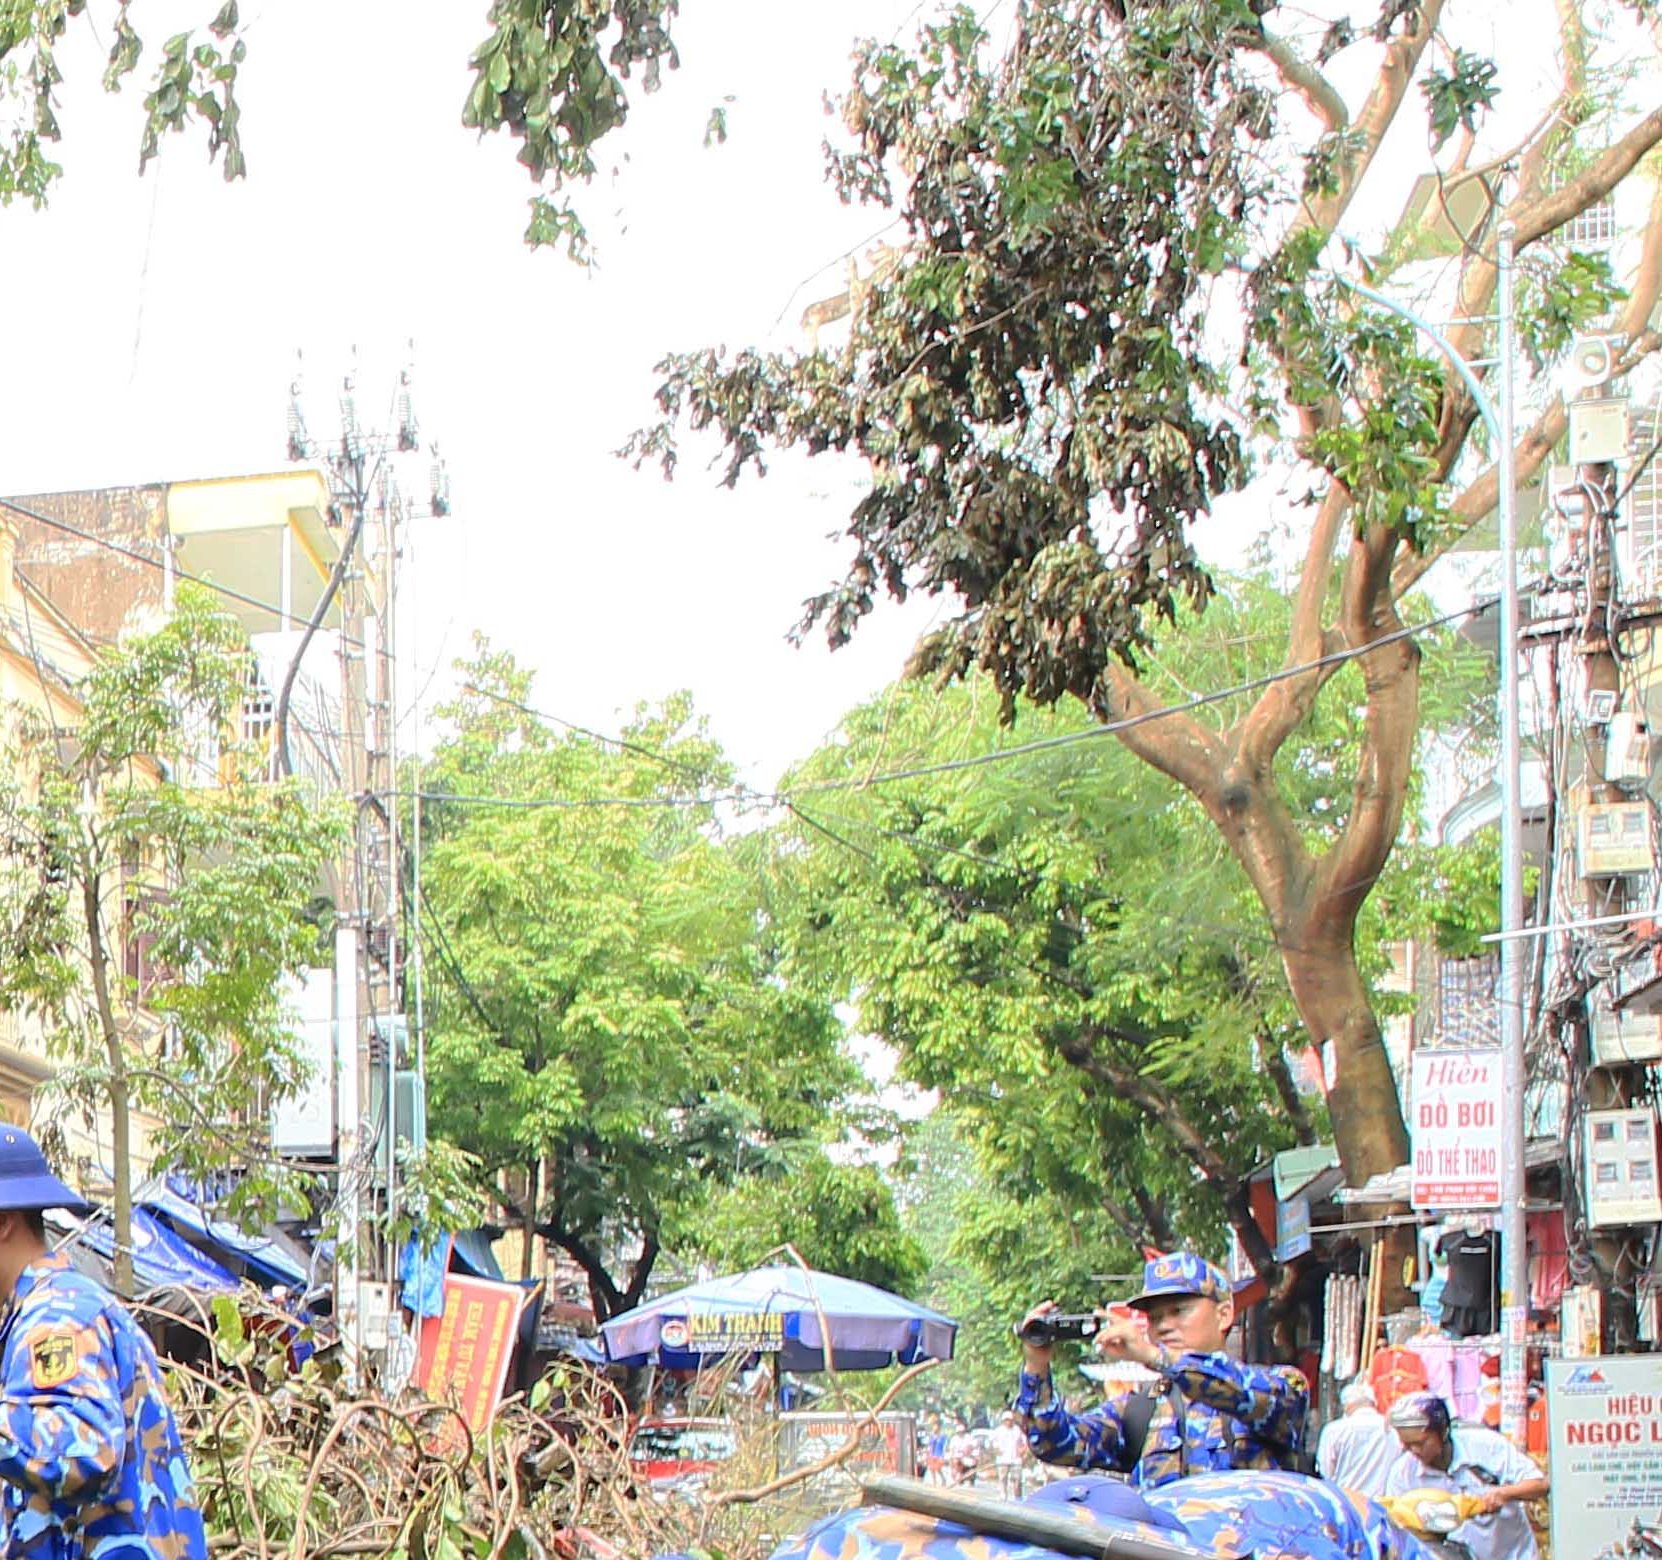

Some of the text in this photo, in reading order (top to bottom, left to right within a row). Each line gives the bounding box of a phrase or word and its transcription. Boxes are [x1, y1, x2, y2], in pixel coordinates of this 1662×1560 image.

[1426, 1054, 1490, 1087] Hiền
[1419, 1092, 1495, 1128] ĐỒ BƠI
[1416, 1135, 1497, 1177] ĐỒ THỂ THAO
[1607, 1391, 1653, 1420] HIỆU
[1566, 1420, 1642, 1450] NGỌC
